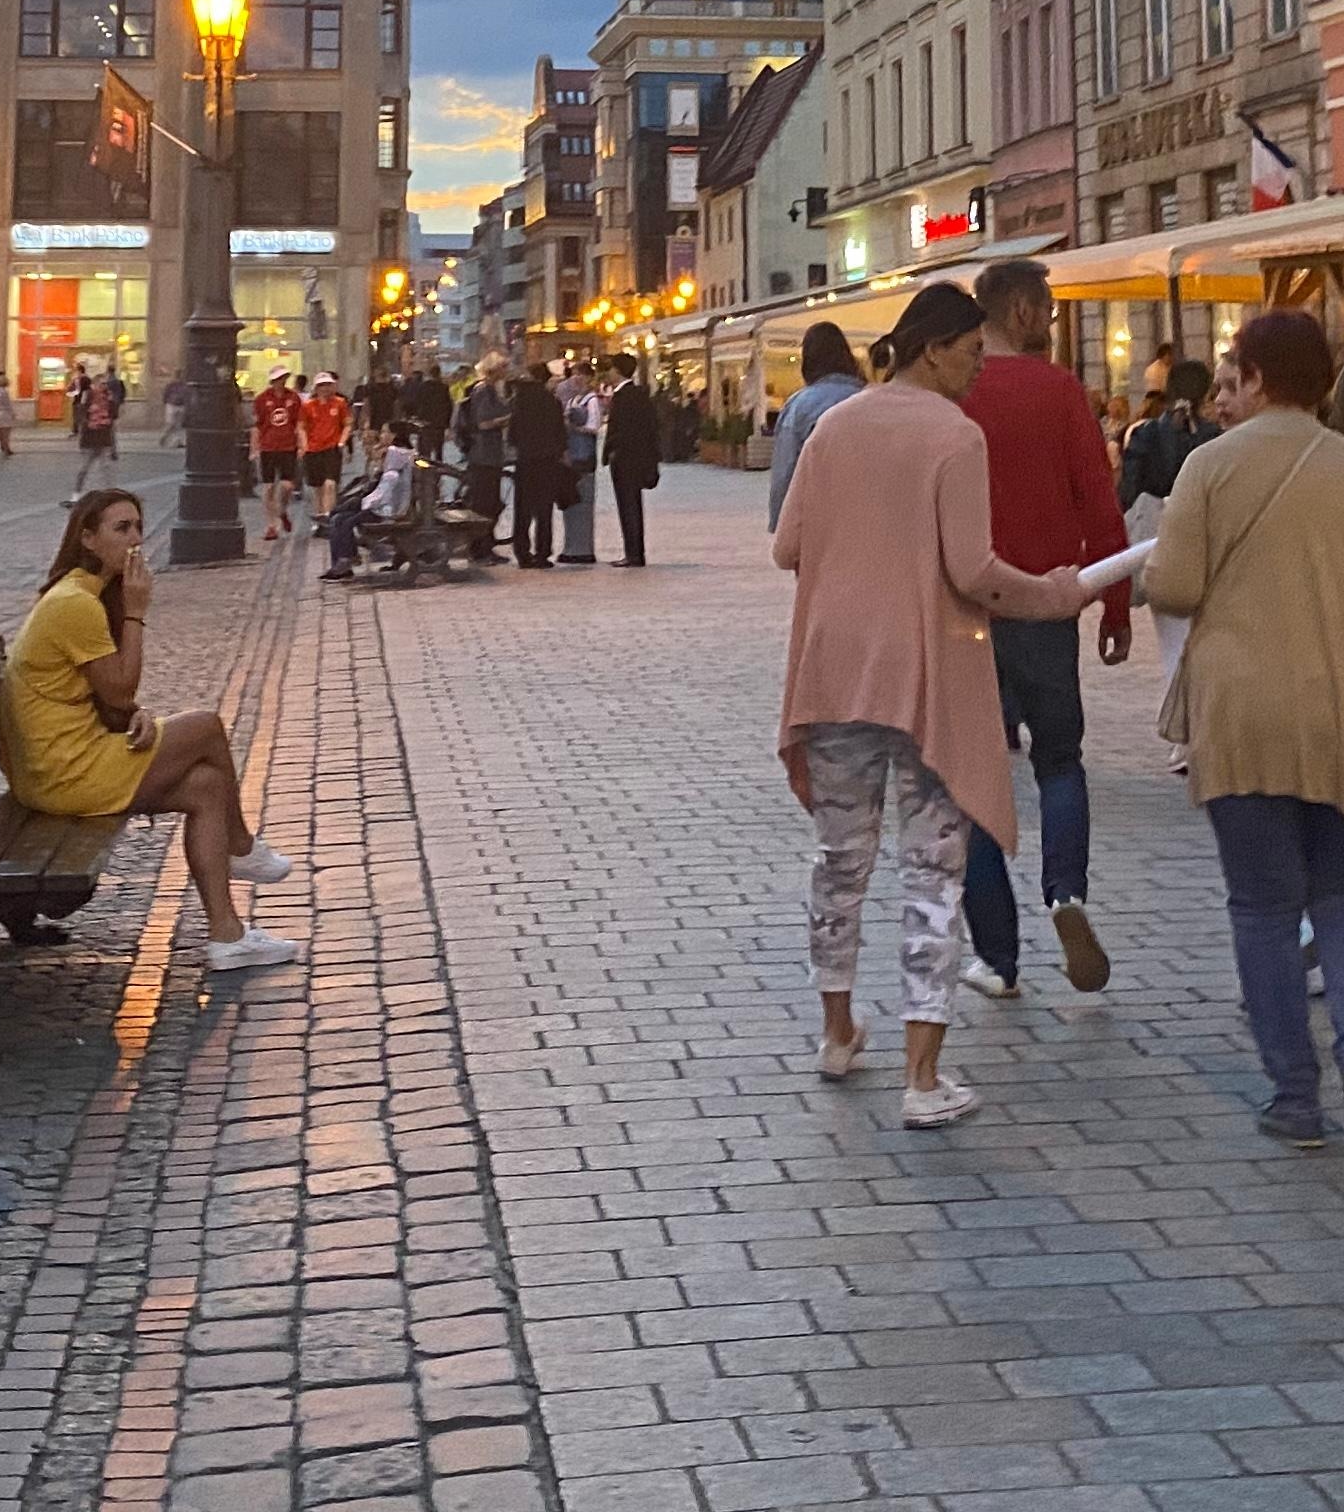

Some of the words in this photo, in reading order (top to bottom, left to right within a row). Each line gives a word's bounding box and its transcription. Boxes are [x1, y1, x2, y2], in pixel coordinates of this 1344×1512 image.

[50, 226, 91, 244] Bank
[96, 228, 145, 245] Pekao
[243, 231, 282, 249] Bank
[285, 232, 332, 249] Pekao
